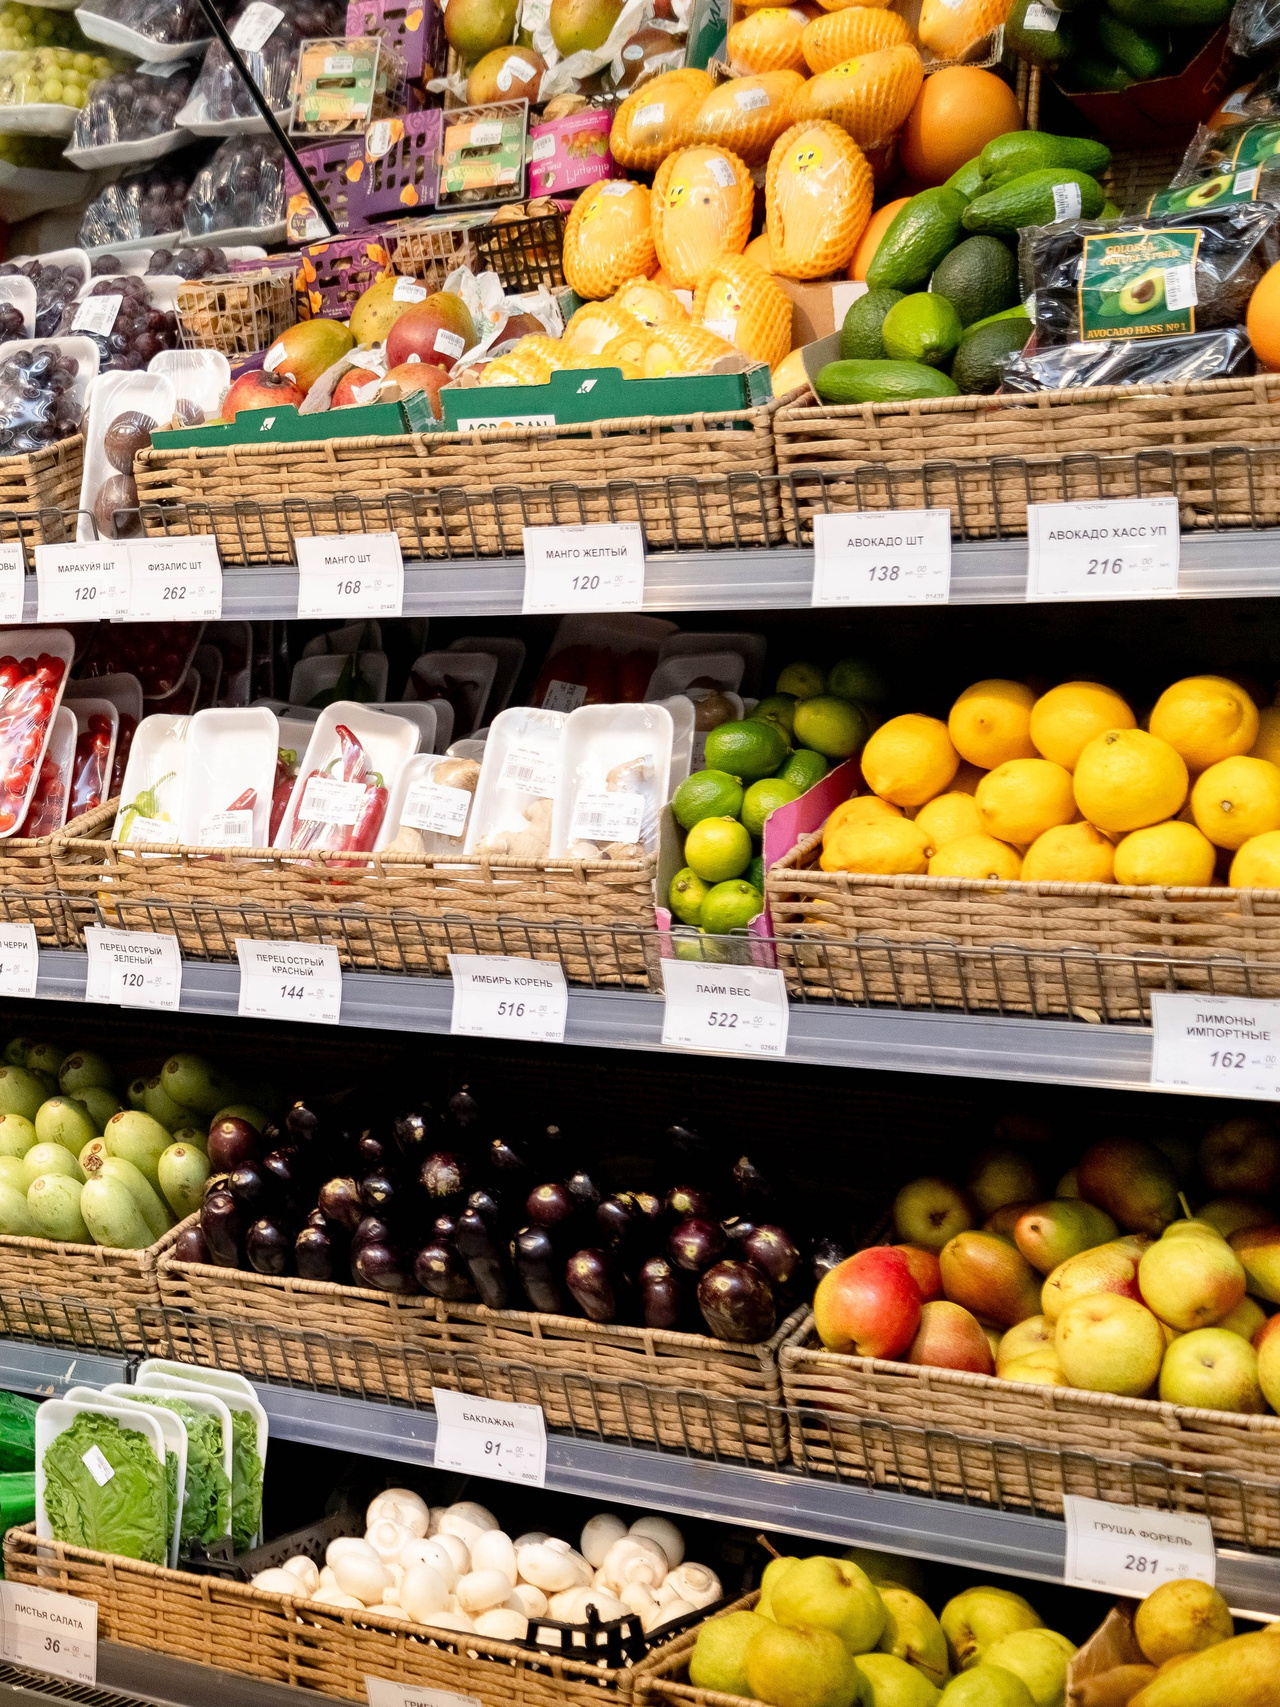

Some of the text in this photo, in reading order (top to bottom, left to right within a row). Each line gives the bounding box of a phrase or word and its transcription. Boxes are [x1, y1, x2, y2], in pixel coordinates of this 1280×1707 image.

[1087, 322, 1187, 338] AVOCADO HASS 1
[1048, 526, 1167, 541] АВОКАДО ХАСС УП
[847, 536, 925, 548] АВОКАДО ШТ
[546, 545, 628, 559] МАНГО ЖЕЛТЫЙ
[147, 561, 202, 571] ФИЗАЛИС ШТ
[324, 554, 371, 565] МАНГО ШТ
[1087, 558, 1124, 575] 216
[57, 561, 116, 573] МАРАКУЙЯ ШТ
[868, 565, 900, 581] 138
[336, 580, 361, 595] 168
[572, 576, 600, 590] 120
[74, 587, 97, 601] 120
[163, 586, 187, 600] 262
[3, 941, 29, 950] ЧЕРРИ
[100, 942, 163, 956] ПЕРЕЦ ОСТРЫЙ
[113, 954, 153, 965] ЗЕЛЕНЫЙ
[256, 953, 325, 967] ПЕРЕЦ ОСТРЫЙ
[272, 965, 314, 977] КРАСНЫЙ
[122, 973, 144, 987] 120
[471, 974, 553, 988] ИМБИРЬ КОРЕНЬ
[280, 984, 305, 1000] 144
[696, 983, 752, 997] ЛАЙМ ВЕС
[497, 1001, 526, 1017] 516
[708, 1011, 739, 1028] 522
[1196, 1013, 1256, 1027] ЛИМОНЫ
[1186, 1026, 1272, 1042] ИМПОРТНЫЕ
[1210, 1051, 1247, 1069] 162
[462, 1412, 515, 1429] БАКЛАЖАН
[484, 1440, 502, 1456] 91
[1093, 1521, 1193, 1547] ГРУША ФОРЕЛЬ
[1124, 1554, 1159, 1575] 281
[14, 1602, 84, 1631] ЛИСТЬЯ САЛАТА
[44, 1636, 61, 1654] 36
